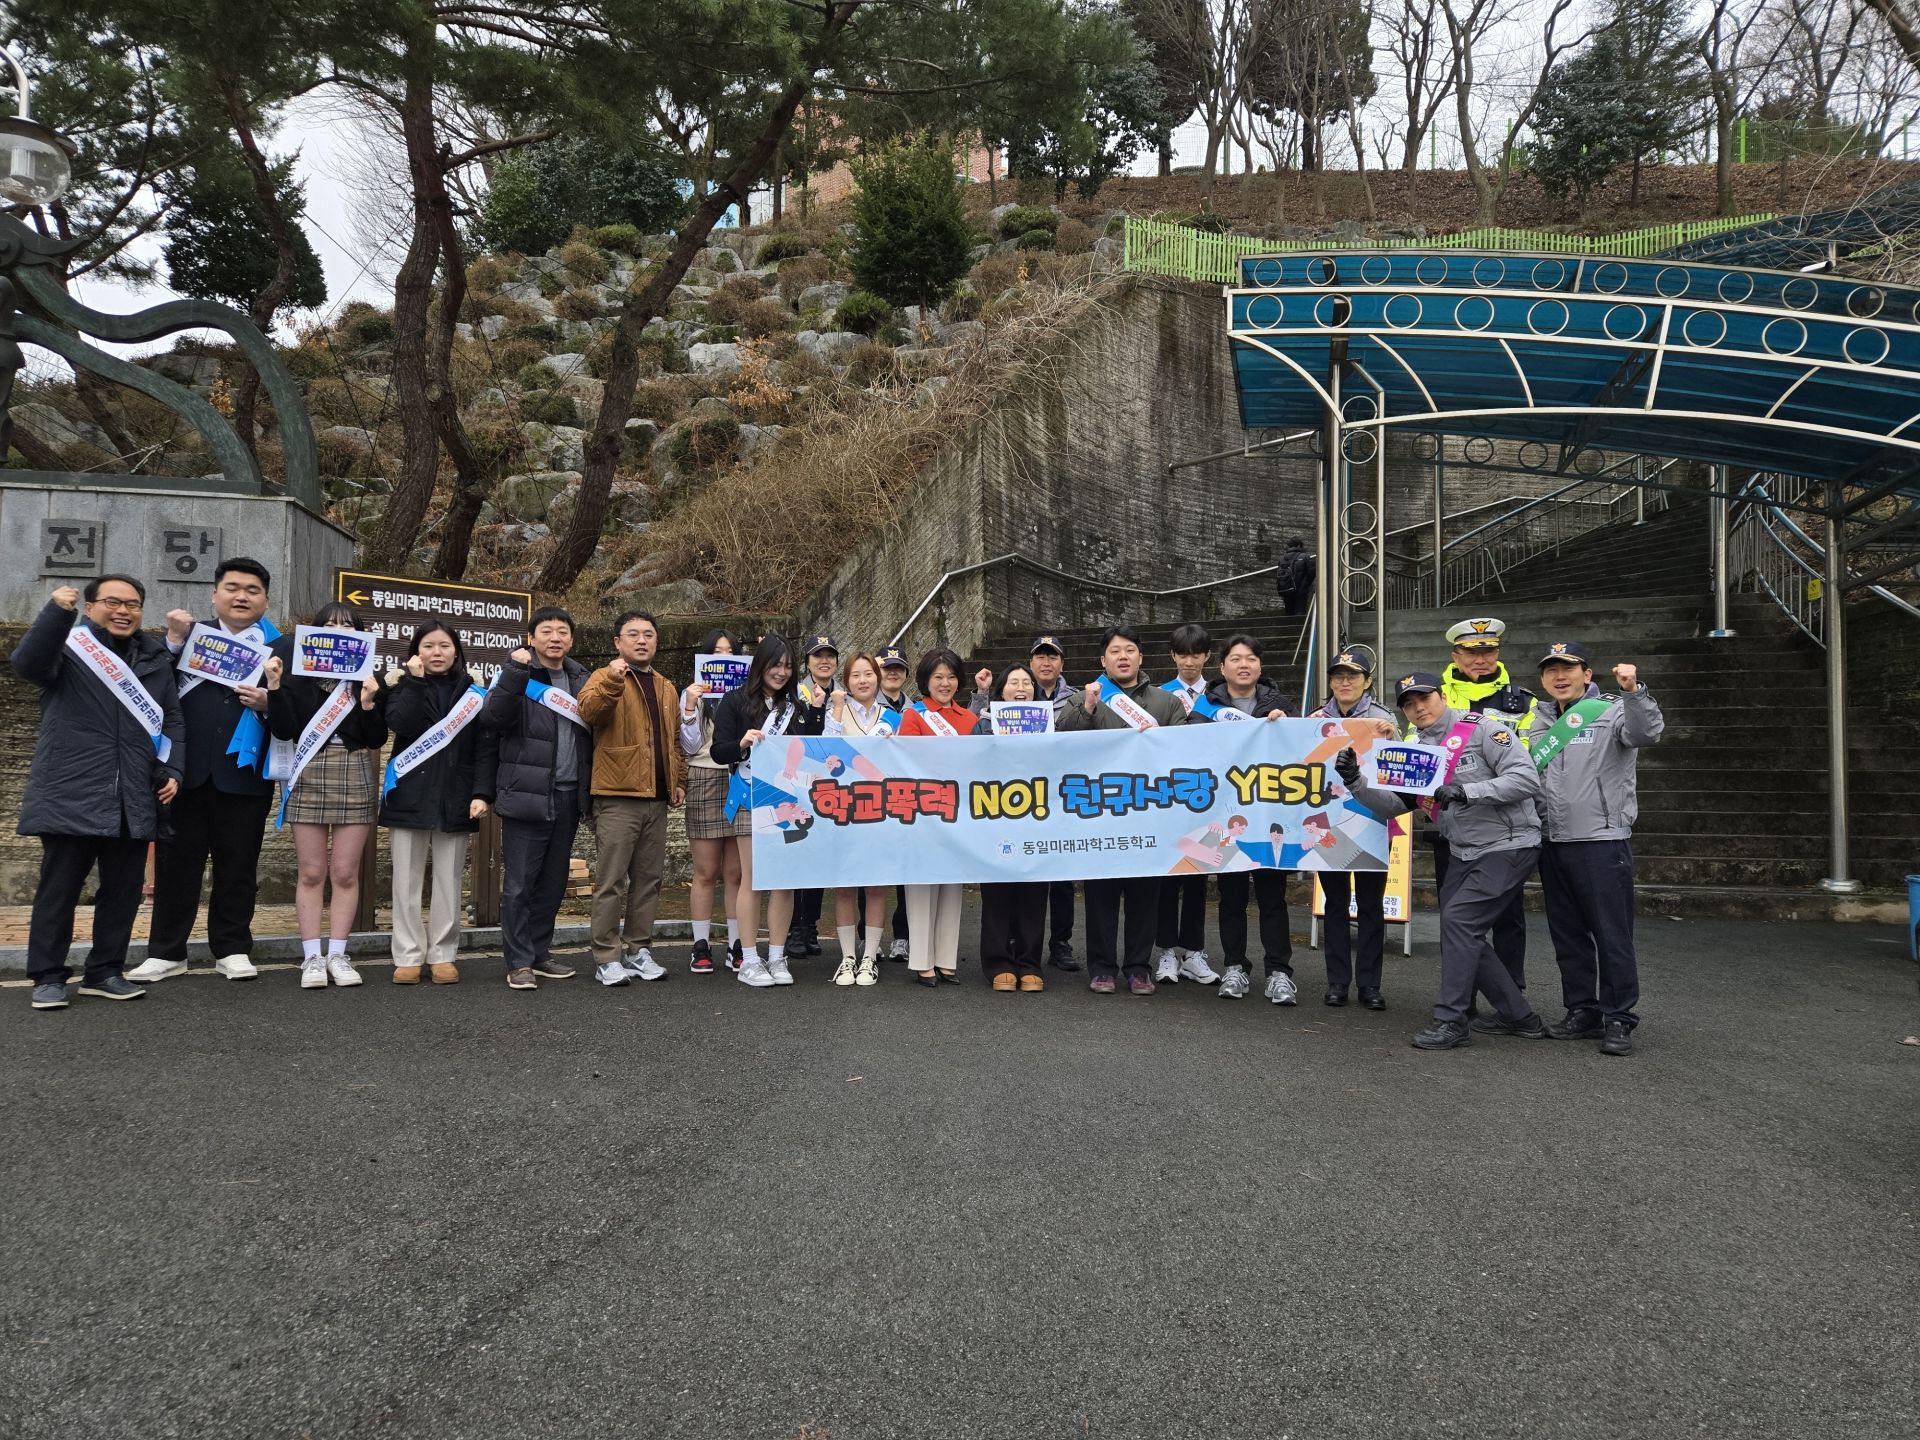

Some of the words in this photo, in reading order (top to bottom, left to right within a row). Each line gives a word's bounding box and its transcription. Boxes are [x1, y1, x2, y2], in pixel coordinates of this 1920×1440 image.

[372, 590, 523, 622] 동일미래과학고등학교(300m)
[72, 632, 98, 653] 더불어
[193, 634, 229, 653] 사이버
[300, 635, 334, 648] 사이버
[699, 663, 725, 673] 사이버
[995, 709, 1021, 719] 사이버
[1375, 749, 1407, 762] 사이버
[809, 777, 960, 824] 학교폭력
[971, 774, 1051, 821] NO!
[1060, 767, 1218, 816] 친구사랑
[1226, 762, 1328, 807] YES!
[1022, 835, 1157, 855] 동일미래과학고등학교
